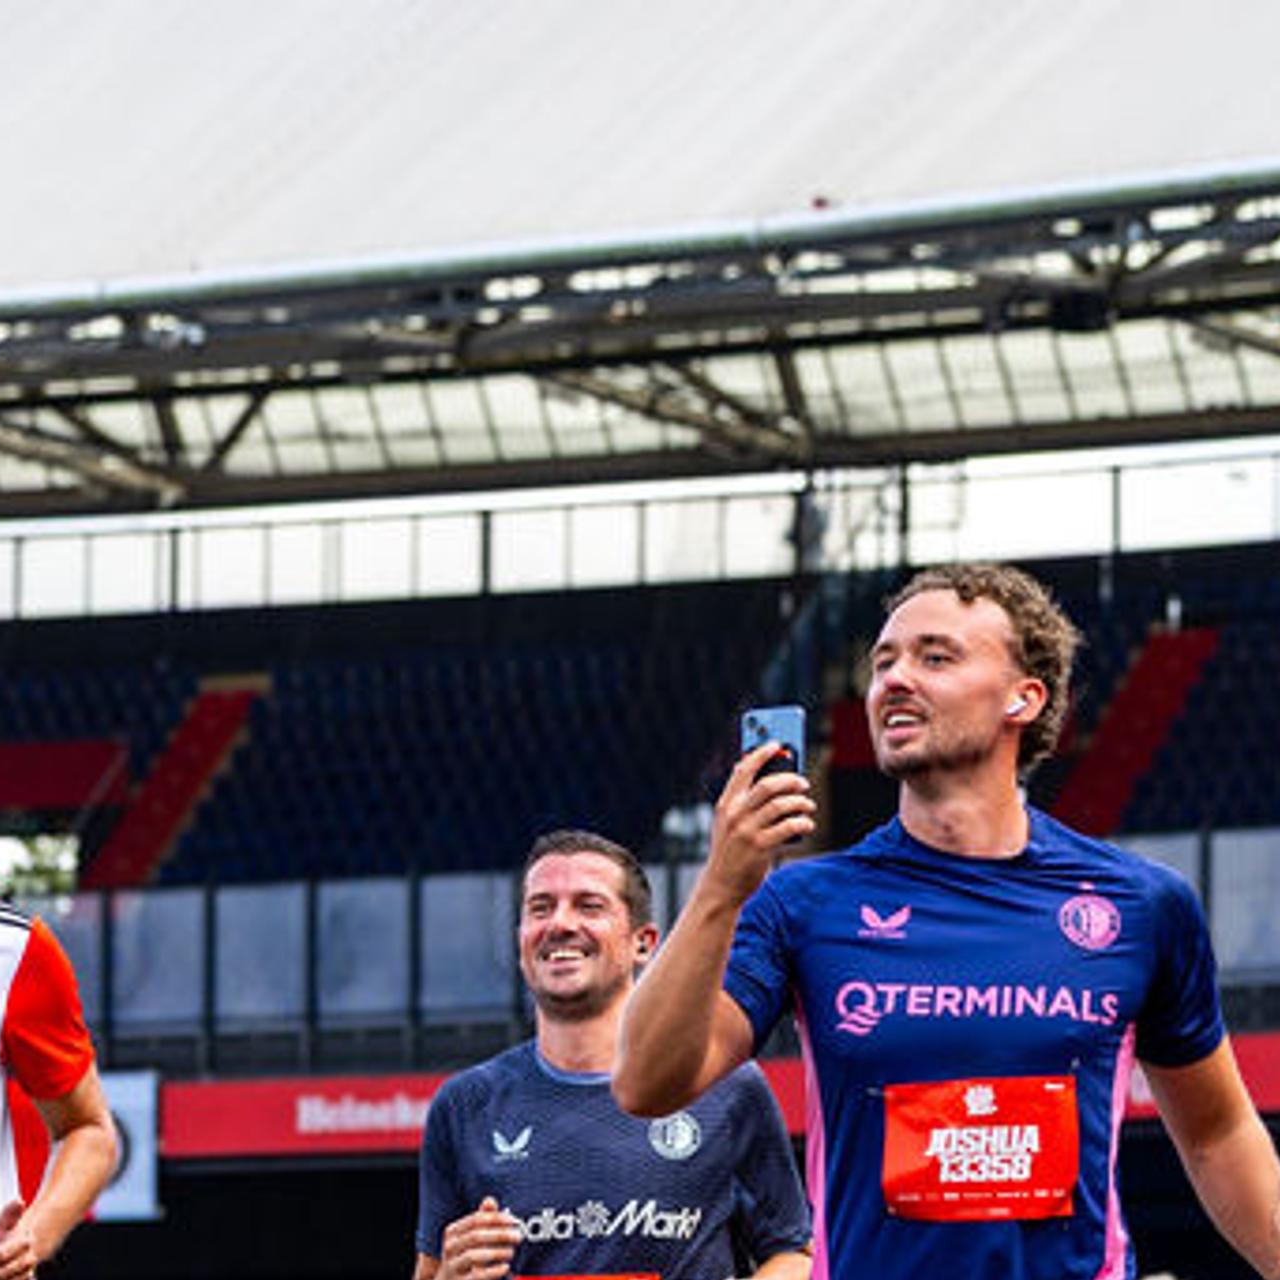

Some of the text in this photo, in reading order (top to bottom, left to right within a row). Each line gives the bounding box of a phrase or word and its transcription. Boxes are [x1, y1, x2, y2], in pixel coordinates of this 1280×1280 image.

[835, 981, 1119, 1036] QTERMINALS
[925, 1125, 1040, 1156] JOSHUA
[937, 1152, 1032, 1183] 13358
[519, 1207, 573, 1241] dia
